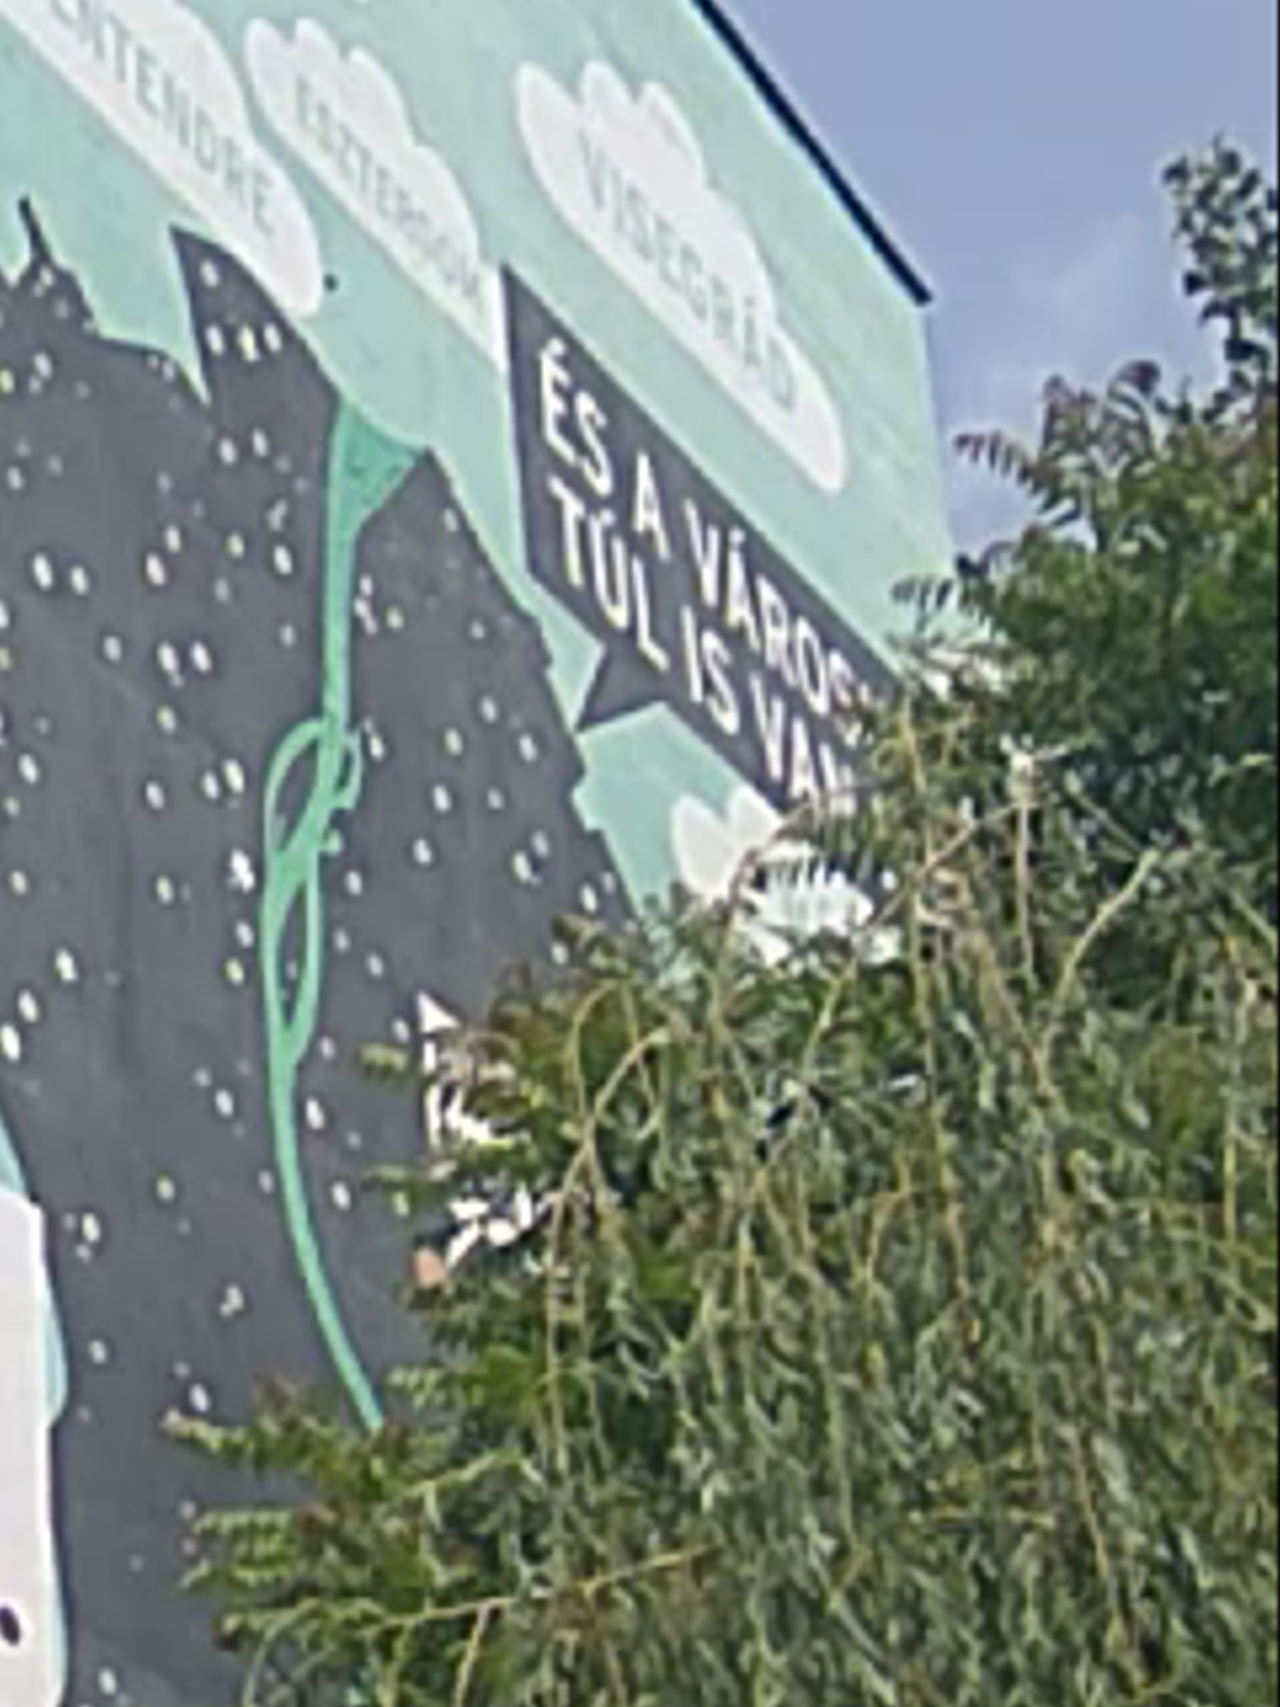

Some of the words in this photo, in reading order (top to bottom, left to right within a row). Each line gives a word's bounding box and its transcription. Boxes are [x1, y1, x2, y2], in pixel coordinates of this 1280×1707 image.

[542, 337, 612, 496] ÉS
[633, 452, 670, 560] A
[548, 475, 669, 673] TÚL
[682, 605, 740, 736] IS
